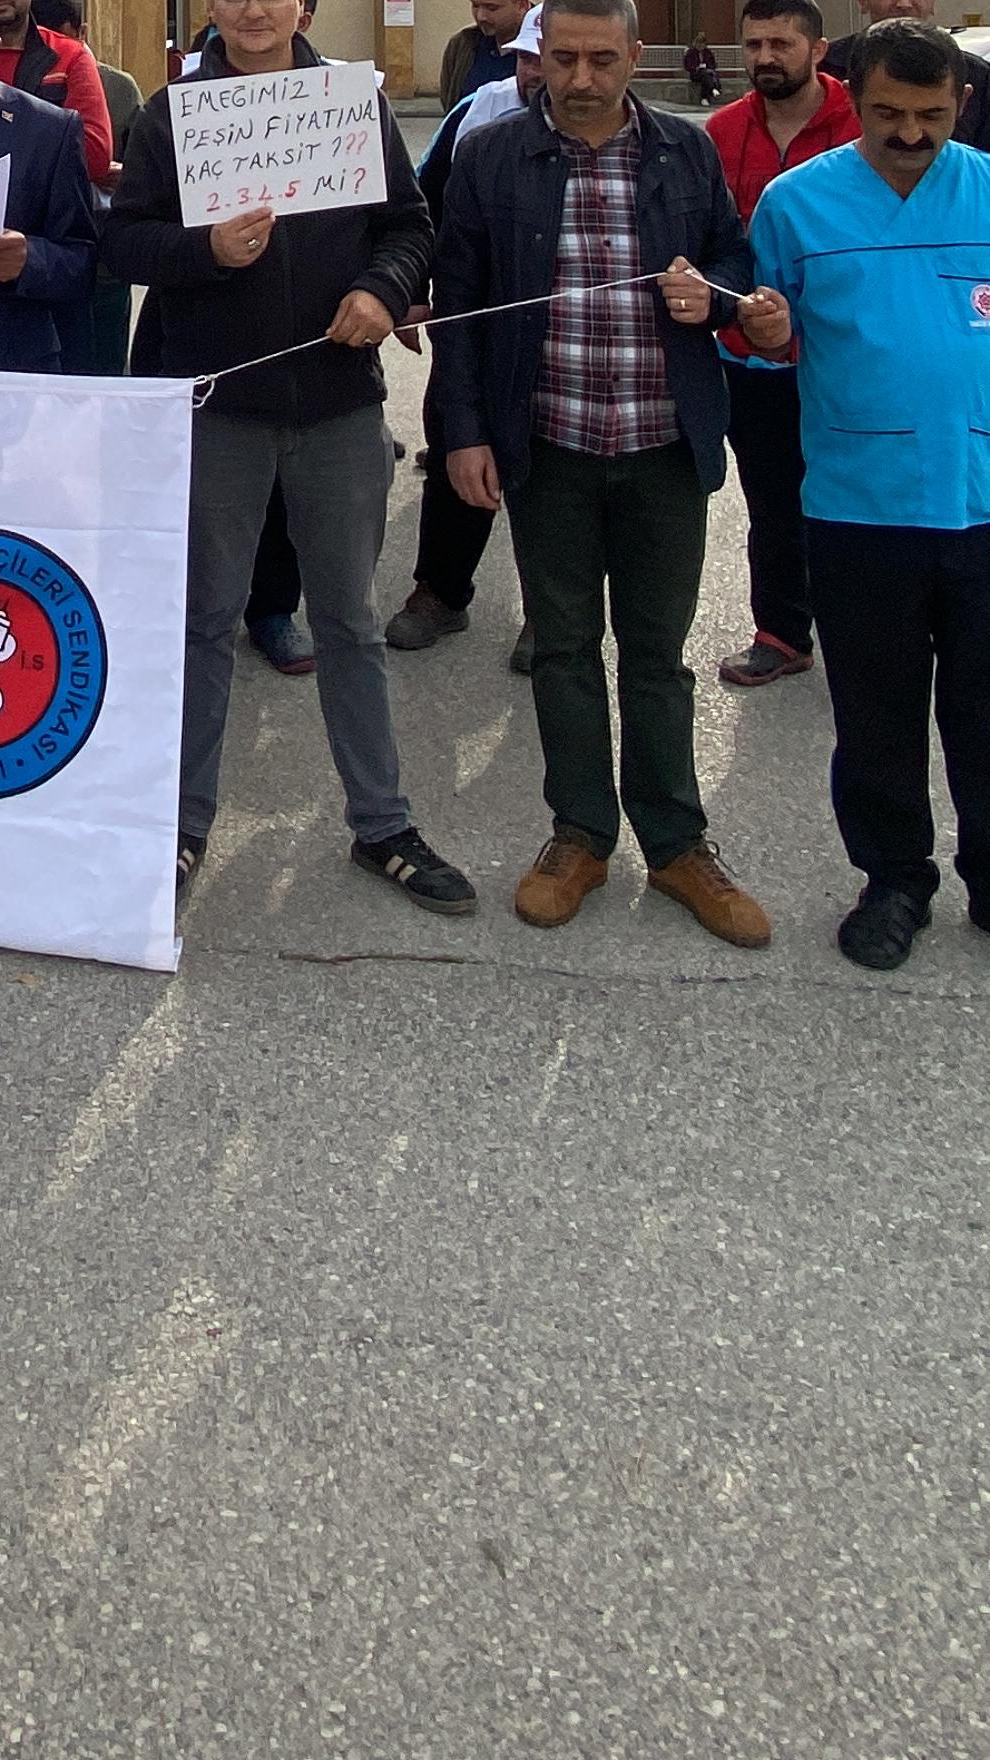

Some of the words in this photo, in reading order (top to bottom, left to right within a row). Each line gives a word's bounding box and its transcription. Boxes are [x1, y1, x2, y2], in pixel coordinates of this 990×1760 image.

[180, 77, 310, 119] EMEĞİMİZ
[182, 118, 254, 153] PEŞİN
[265, 99, 378, 139] FİYATINA
[184, 160, 224, 185] KAÇ
[234, 142, 321, 173] TAKSİT
